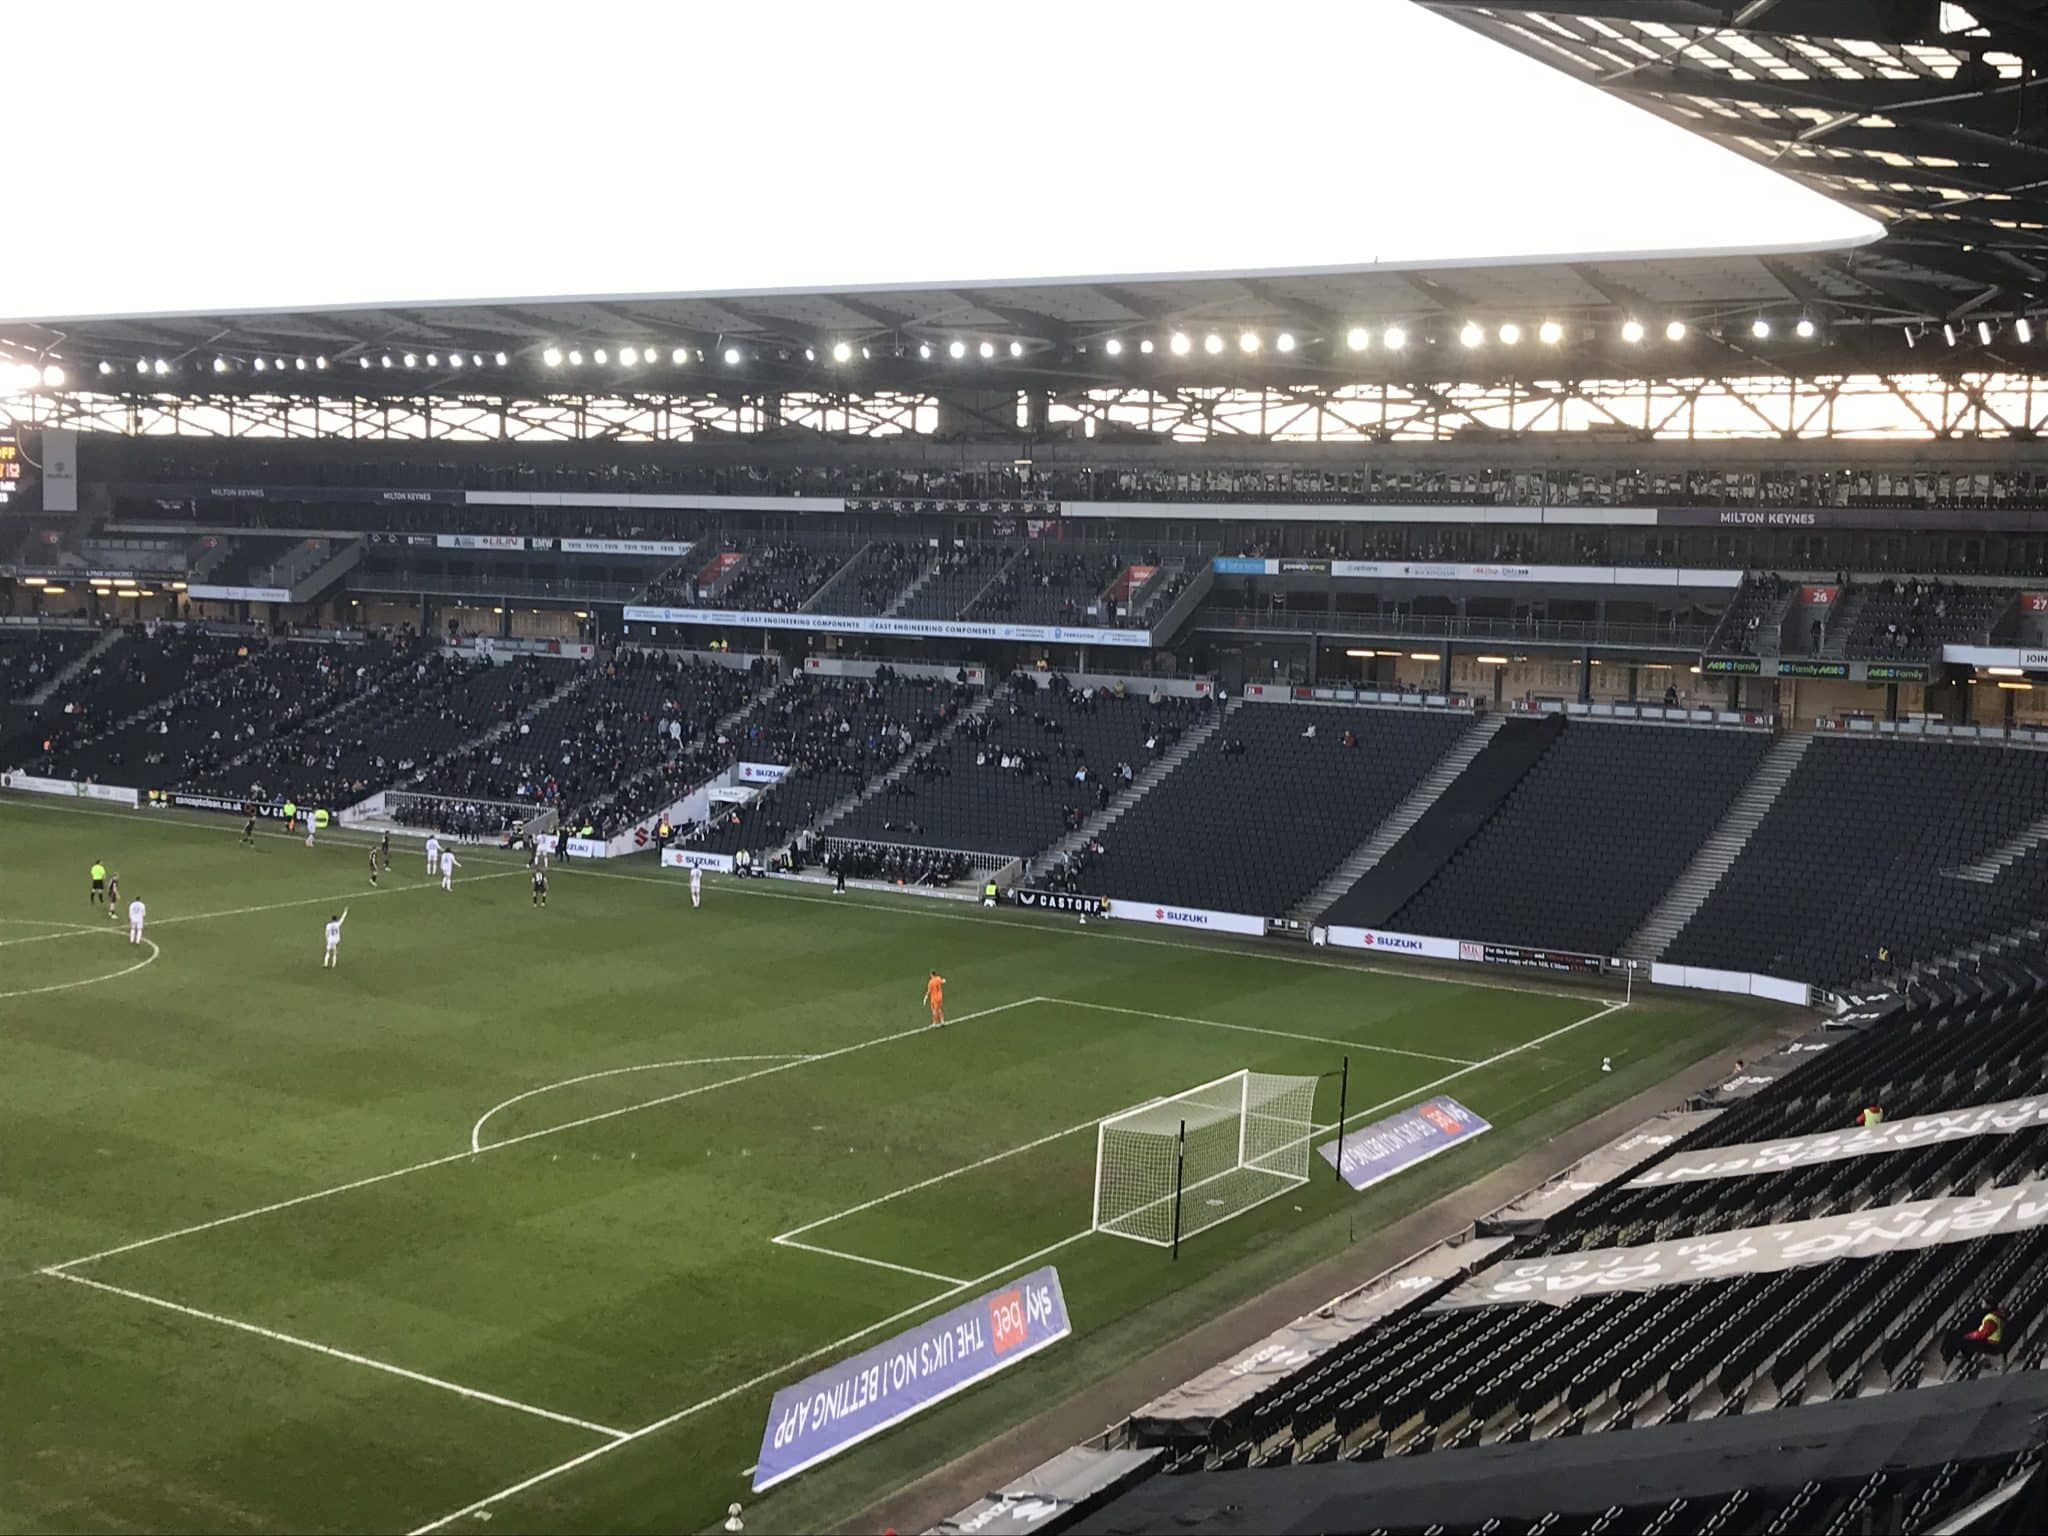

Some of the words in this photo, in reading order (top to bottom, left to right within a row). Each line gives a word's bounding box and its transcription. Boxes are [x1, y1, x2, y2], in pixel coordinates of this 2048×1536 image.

[384, 492, 406, 501] MILTON
[1720, 512, 1764, 524] MILTON
[1768, 513, 1815, 525] KEYNES
[1813, 591, 1827, 603] 26
[2033, 599, 2048, 611] 27
[764, 617, 811, 626] ENGINEERING
[812, 619, 860, 629] COMPONENTS
[894, 623, 943, 633] ENGINEERING
[945, 625, 996, 635] COMPONENTS
[685, 856, 720, 867] SUZUKI
[1166, 911, 1208, 924] SUZUKI
[1377, 937, 1423, 950] SUZUKI
[1631, 1108, 2048, 1183] ANAGEMENT
[1846, 1189, 2048, 1230] IONS
[1515, 1231, 1793, 1277] LIMITED
[1691, 1247, 1758, 1272] &
[1487, 1262, 1662, 1299] GAS
[992, 1300, 1023, 1340] bet
[1025, 1285, 1053, 1326] sky
[957, 1317, 984, 1359] THE
[921, 1331, 954, 1377] UK'S
[812, 1365, 880, 1431] BETTING
[773, 1404, 809, 1449] APP
